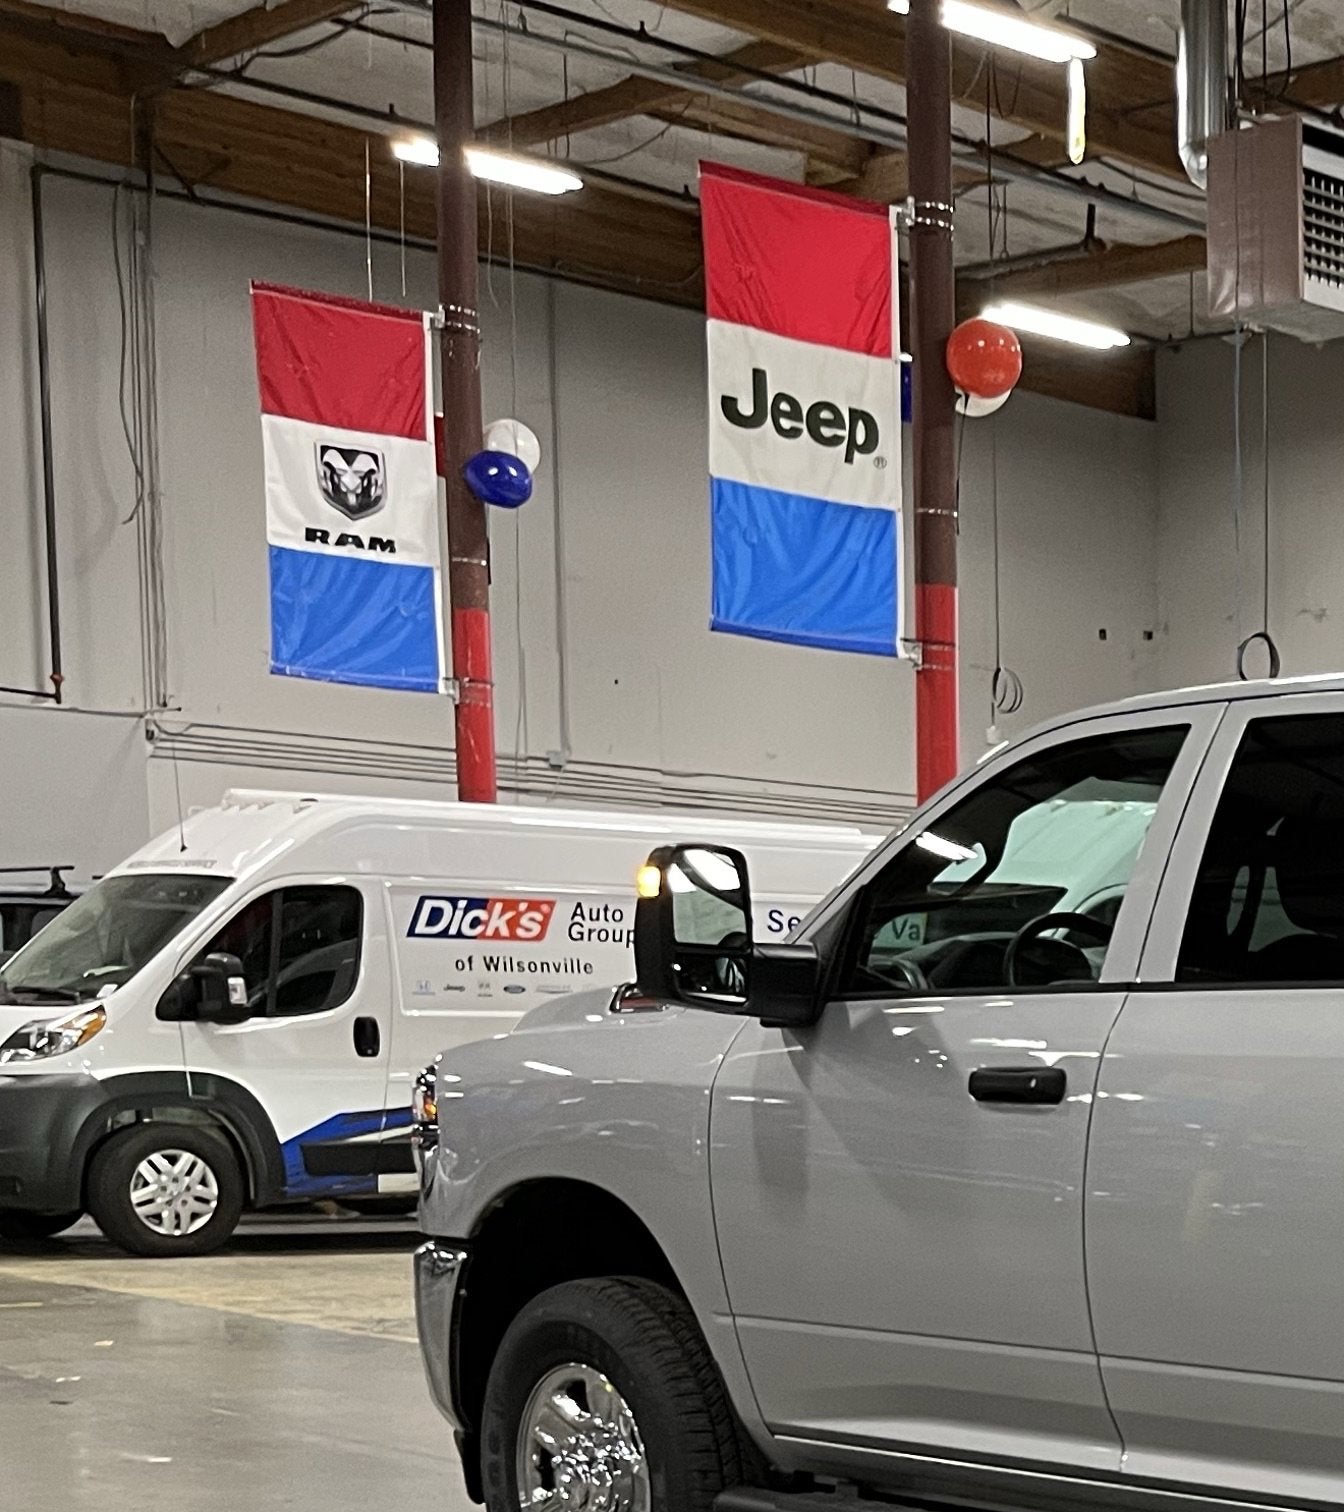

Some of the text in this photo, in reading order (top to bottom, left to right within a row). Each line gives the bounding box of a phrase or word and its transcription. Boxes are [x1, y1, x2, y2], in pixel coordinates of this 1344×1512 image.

[720, 367, 880, 465] Jeep
[304, 526, 397, 554] RAM
[414, 899, 545, 939] Dick's
[570, 901, 624, 922] Auto
[455, 955, 594, 975] of Wilsonville
